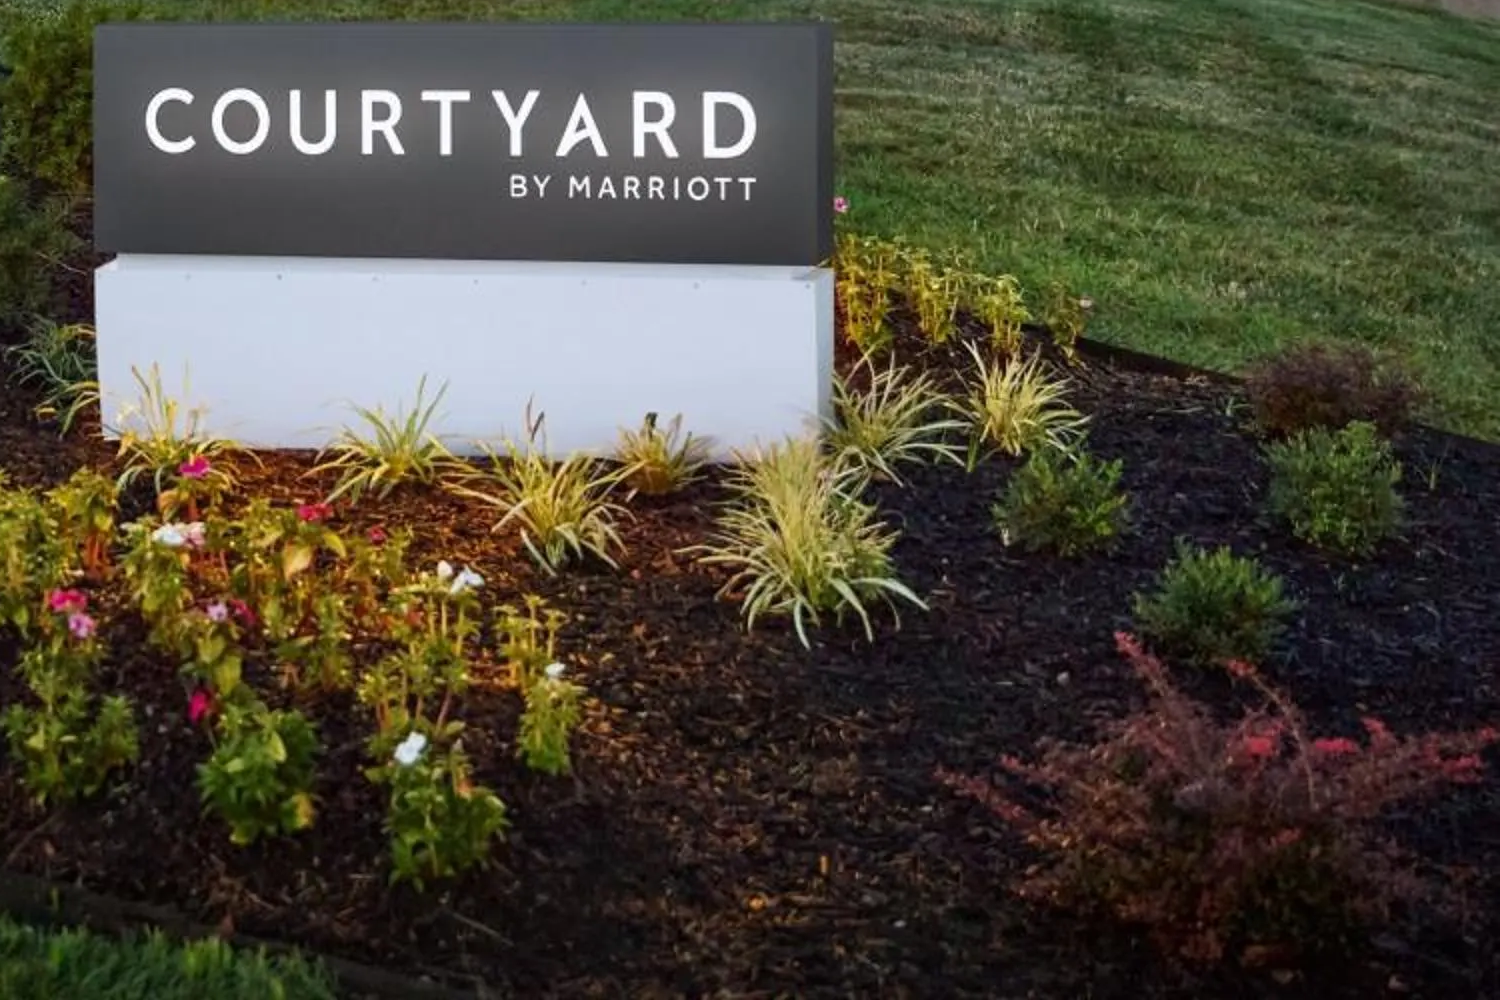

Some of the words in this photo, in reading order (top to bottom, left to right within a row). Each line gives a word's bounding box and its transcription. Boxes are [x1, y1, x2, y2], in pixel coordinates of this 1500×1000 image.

[145, 87, 758, 159] COURTYARD
[510, 174, 550, 199] BY
[568, 175, 757, 201] MARRIOTT
